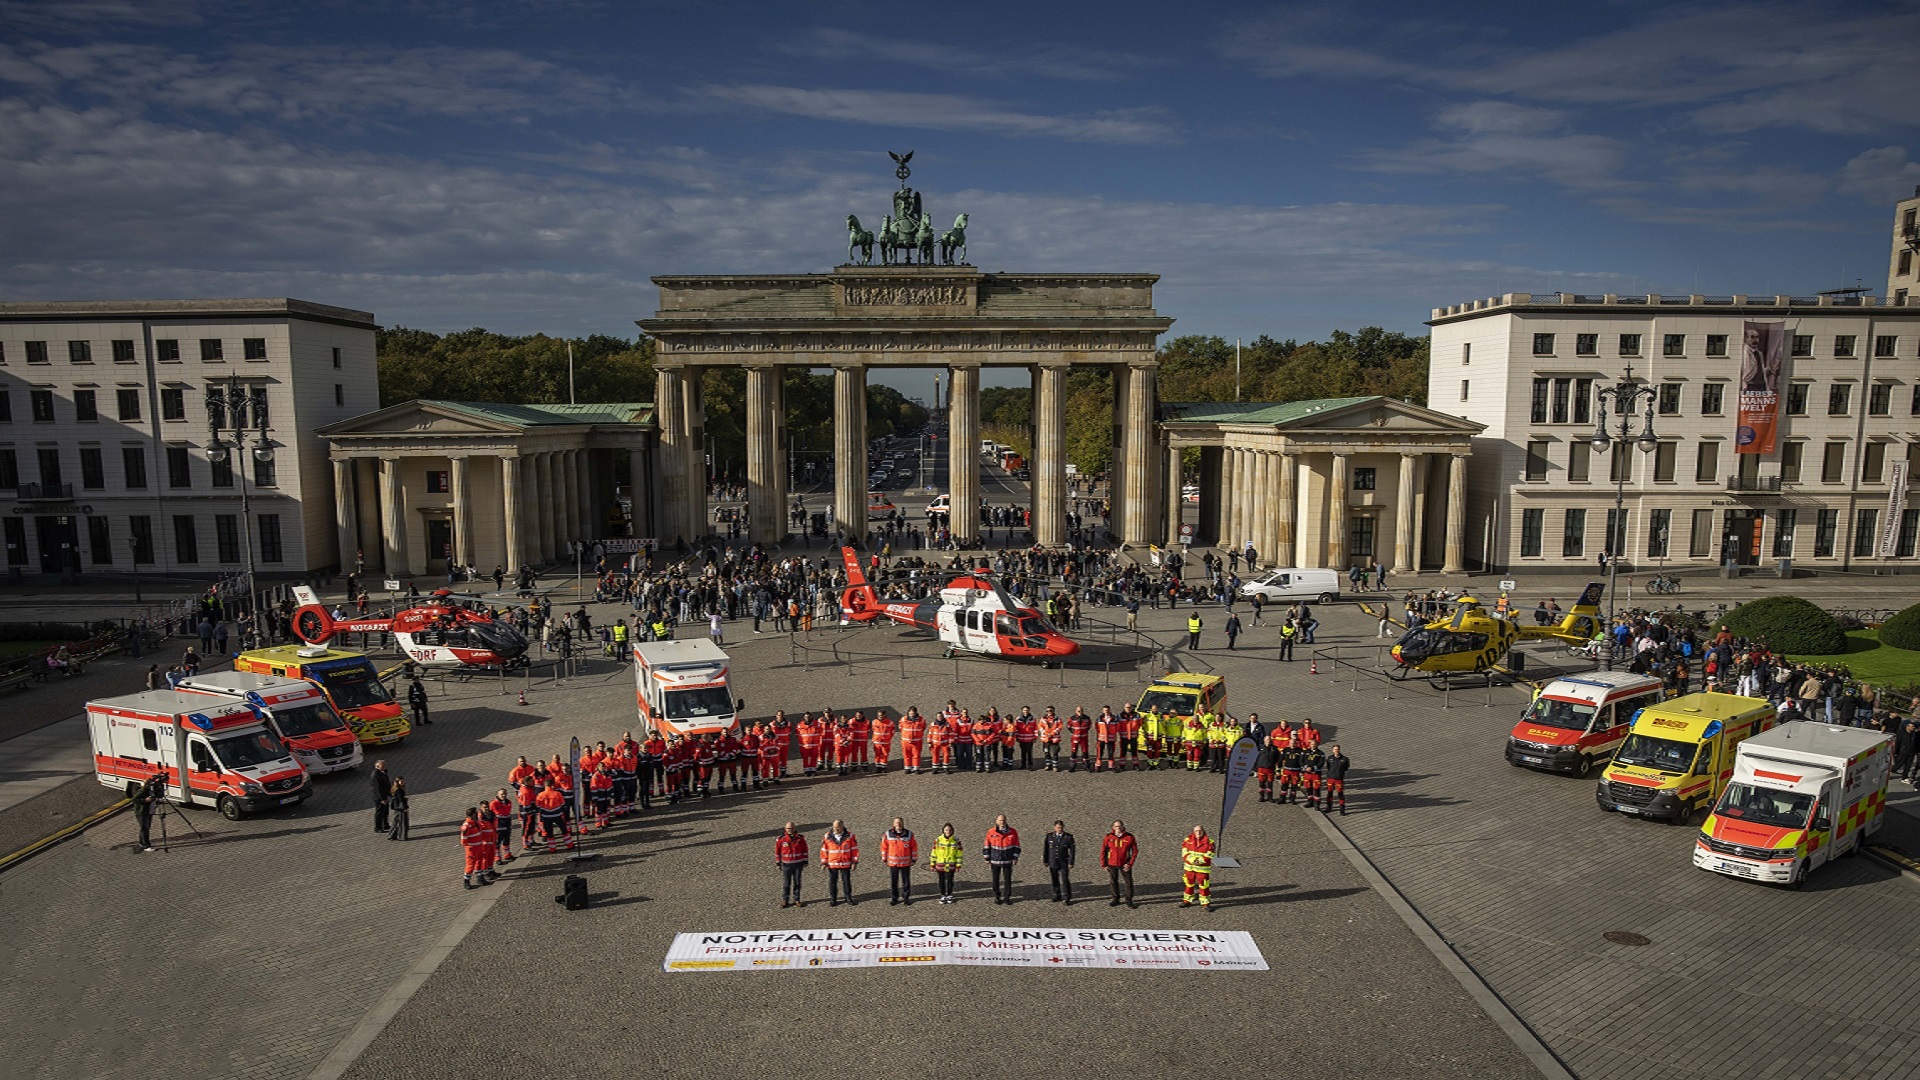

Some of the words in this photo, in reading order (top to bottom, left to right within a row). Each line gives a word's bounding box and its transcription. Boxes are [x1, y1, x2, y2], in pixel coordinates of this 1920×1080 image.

[1740, 397, 1776, 405] MANNS
[416, 650, 437, 660] DRF
[1474, 632, 1514, 673] ADAC
[159, 725, 174, 736] 112
[1528, 728, 1559, 737] DLRG
[701, 929, 1067, 944] NOTFALLVERSORGUNG
[1077, 932, 1226, 943] SICHERN.
[705, 944, 843, 954] Finanzierung
[851, 940, 969, 950] verlässlich.
[977, 941, 1095, 950] Mitsprache
[1103, 944, 1222, 953] verbindlich.
